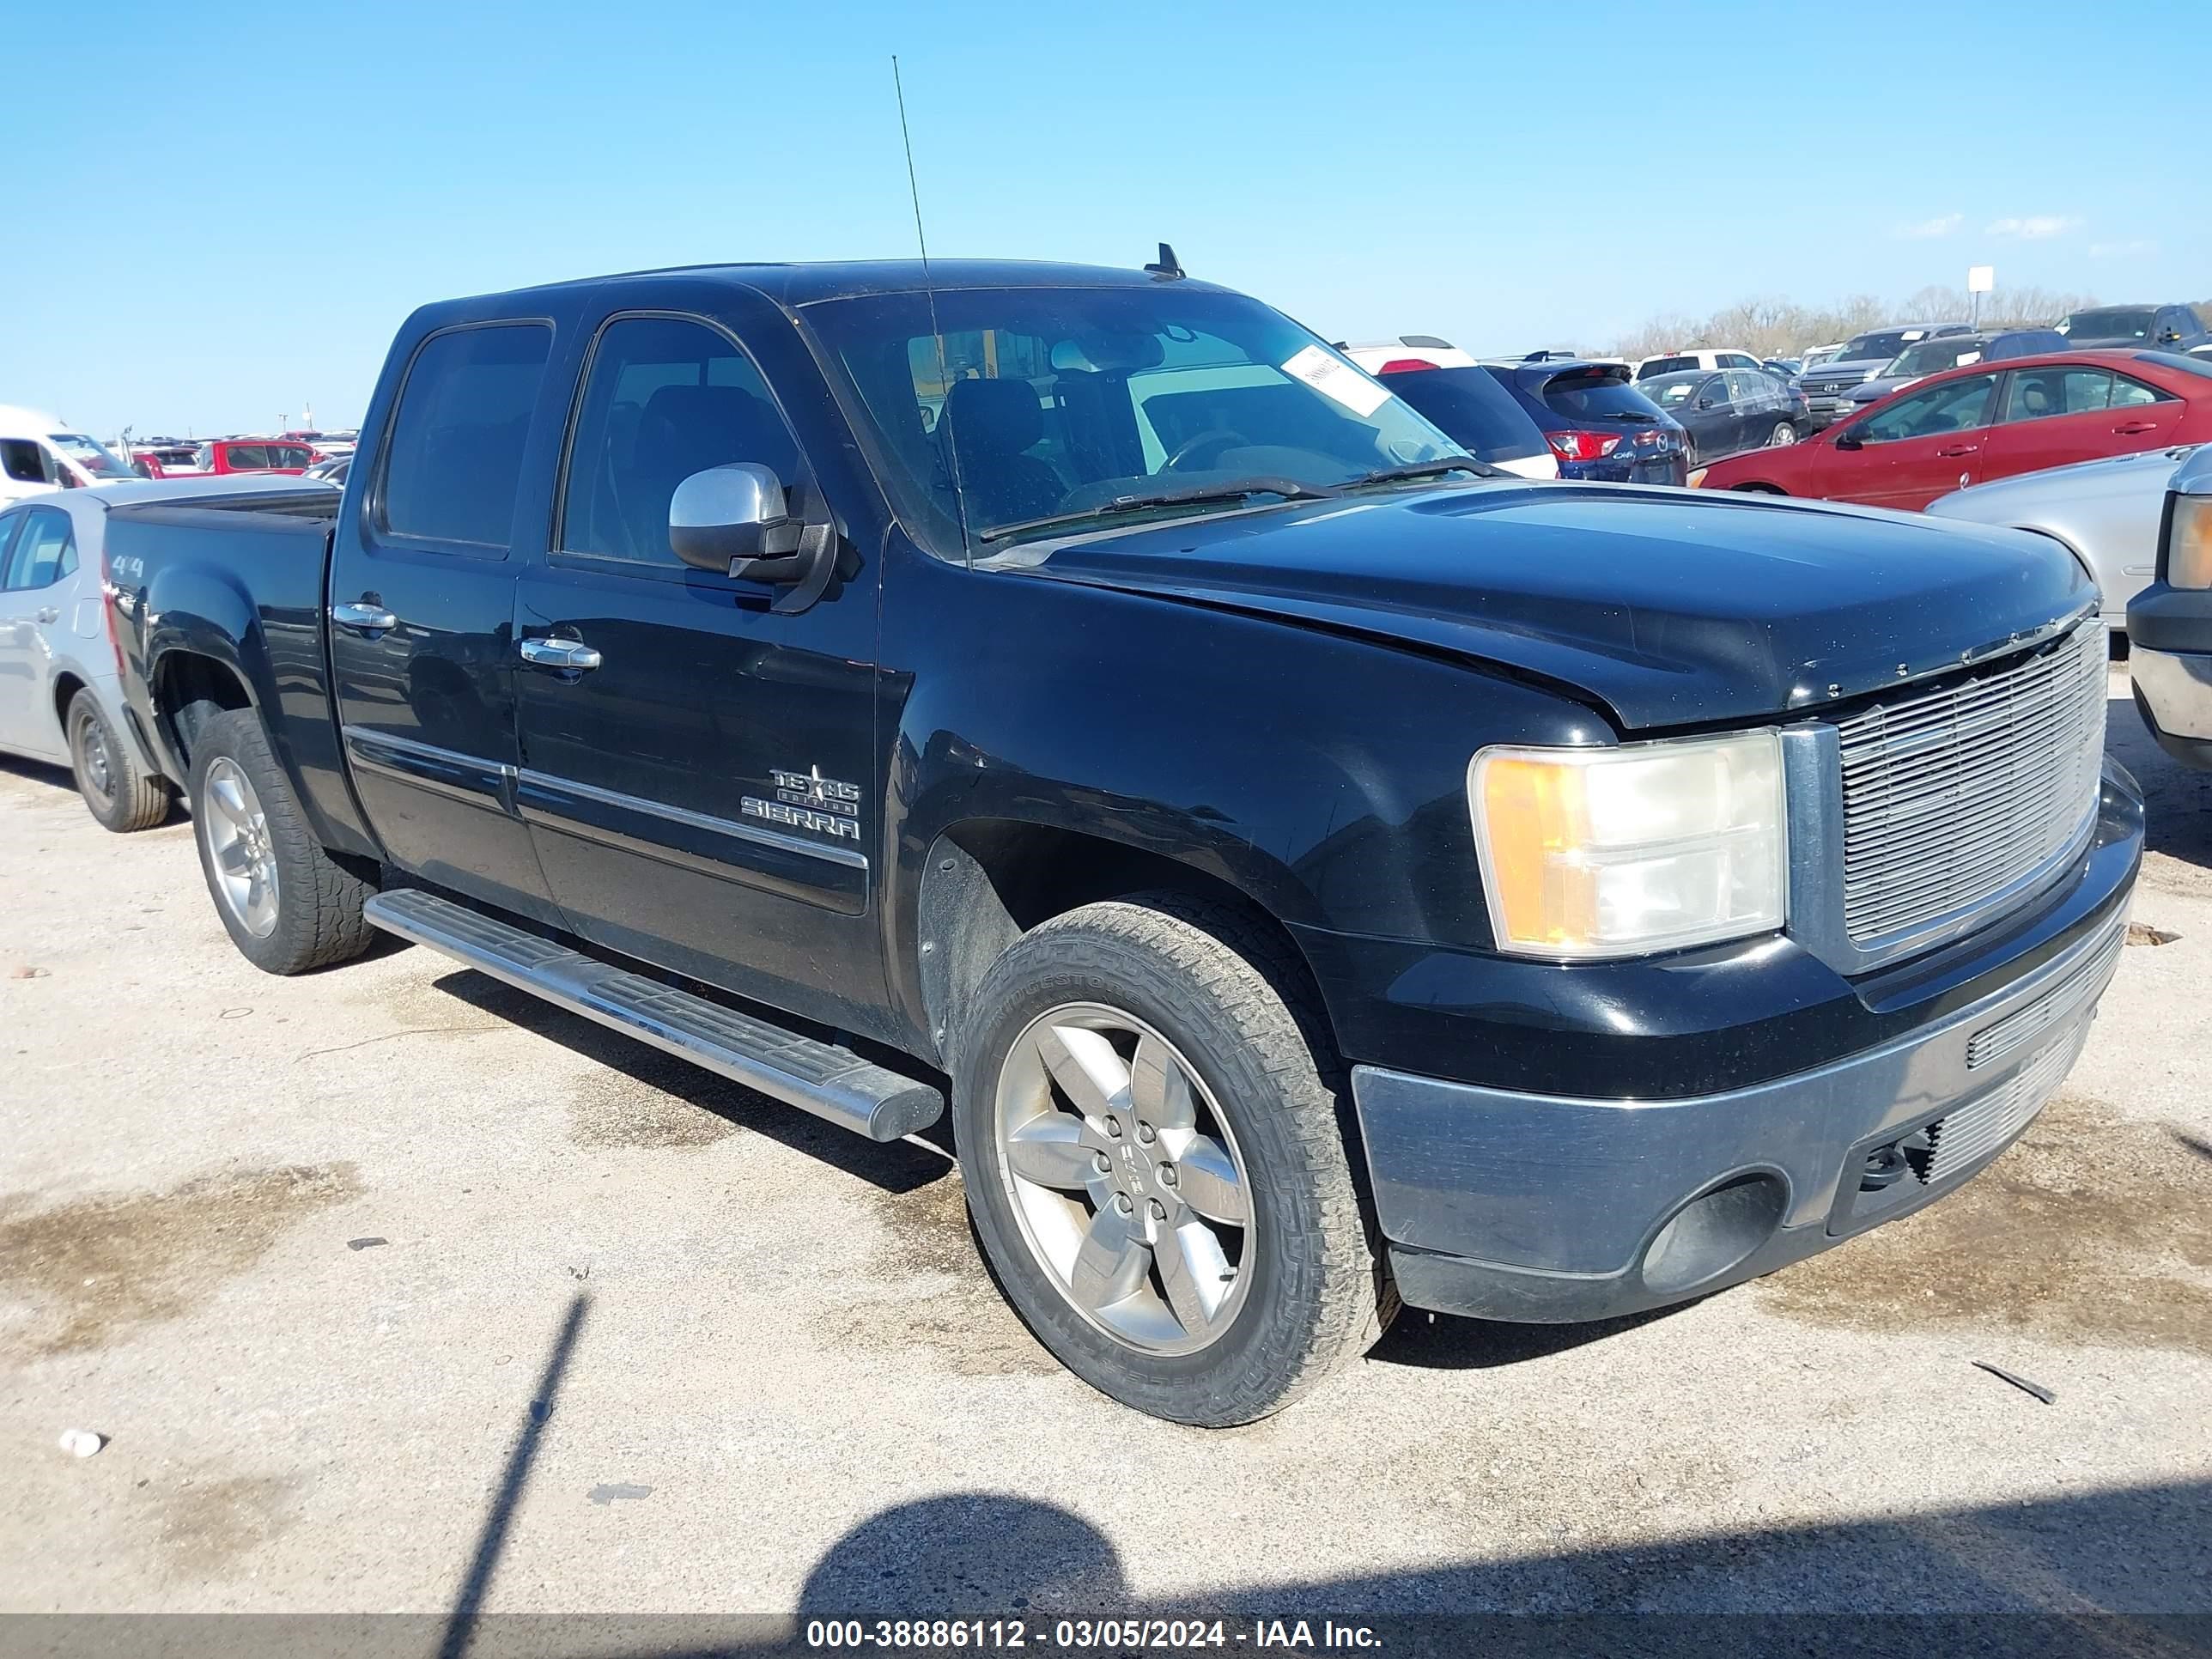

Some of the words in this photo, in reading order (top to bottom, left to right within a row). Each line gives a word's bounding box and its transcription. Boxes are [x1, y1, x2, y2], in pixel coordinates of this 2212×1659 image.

[769, 767, 860, 802] TEXAS
[781, 792, 853, 812] EDITION
[740, 796, 861, 841] SIERRA
